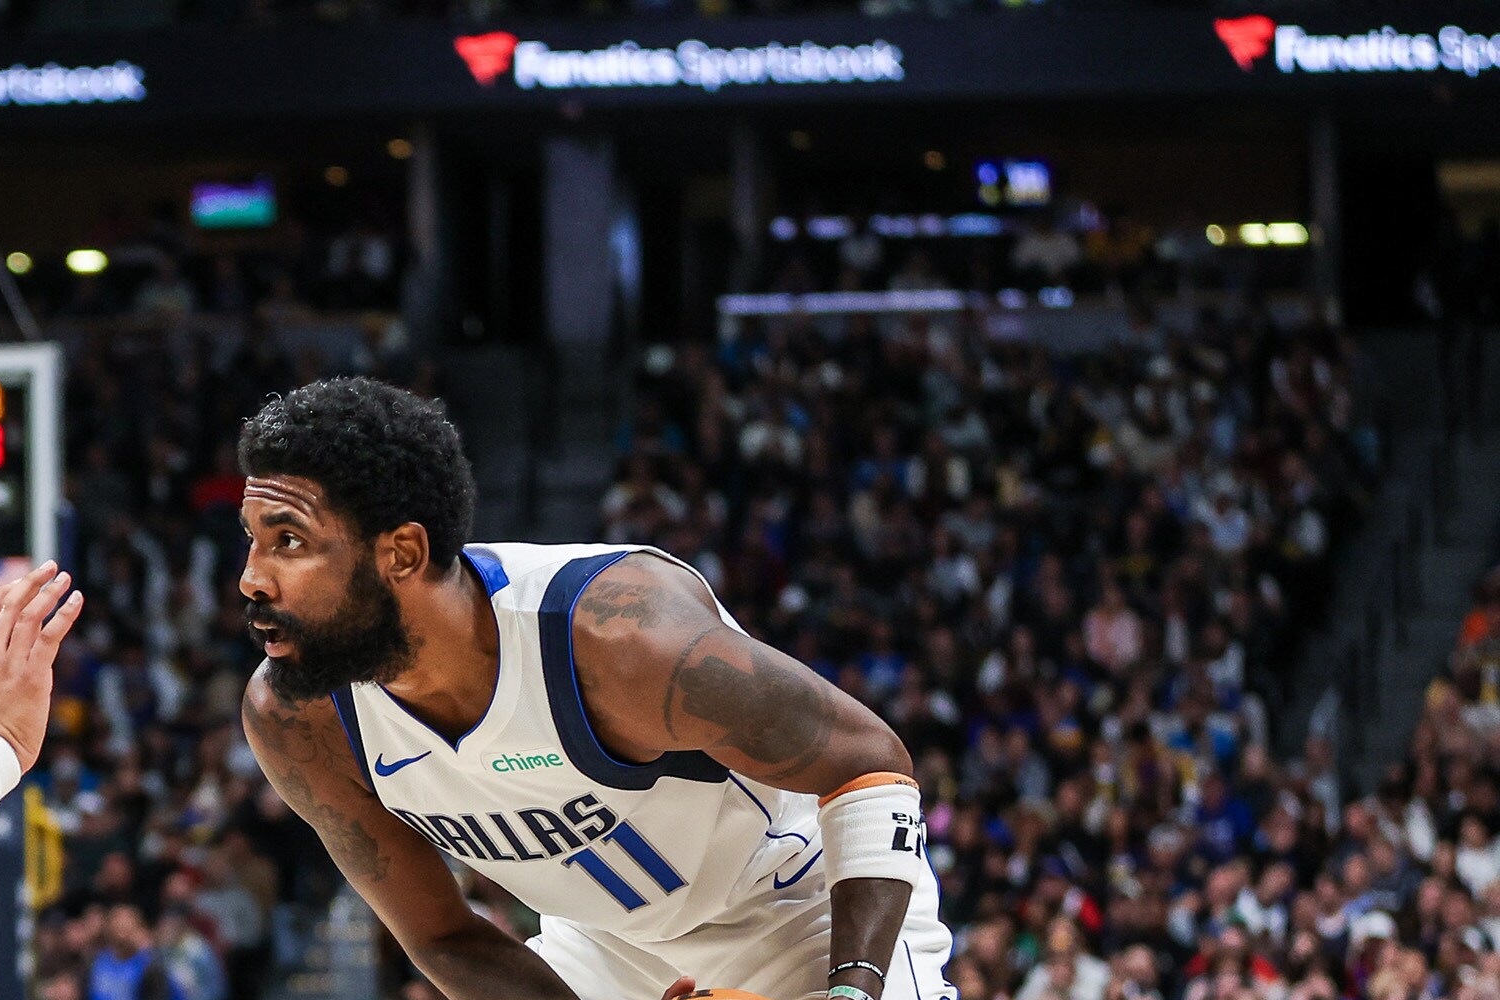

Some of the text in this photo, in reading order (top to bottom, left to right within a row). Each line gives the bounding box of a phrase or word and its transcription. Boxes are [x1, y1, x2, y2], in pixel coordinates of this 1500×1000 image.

[514, 39, 905, 92] Fanatics Sportsbook
[492, 753, 564, 772] chime
[388, 791, 619, 862] DALLAS
[561, 818, 690, 913] 11
